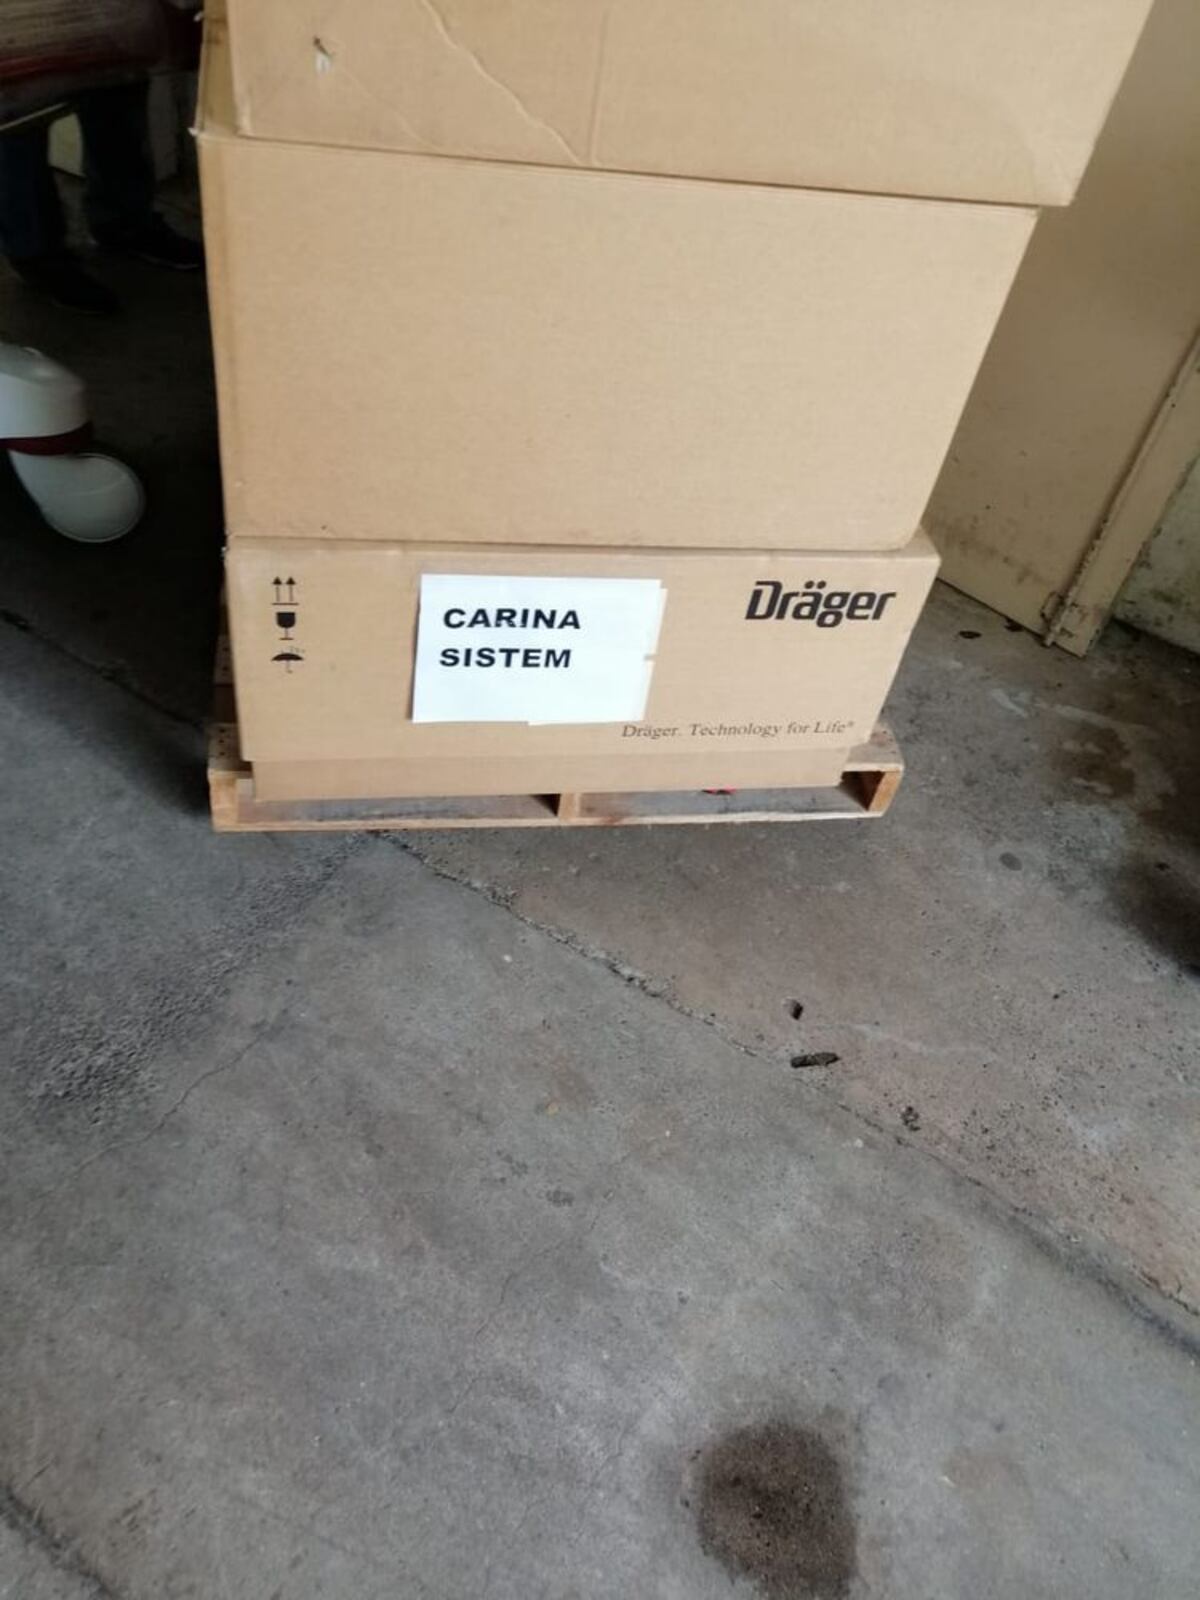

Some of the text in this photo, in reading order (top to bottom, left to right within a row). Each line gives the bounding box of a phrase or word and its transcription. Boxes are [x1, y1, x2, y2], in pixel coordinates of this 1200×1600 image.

[745, 580, 897, 628] Dräger
[443, 608, 581, 629] CARINA
[439, 647, 572, 668] SISTEM
[690, 722, 782, 738] Technology
[787, 721, 811, 735] for
